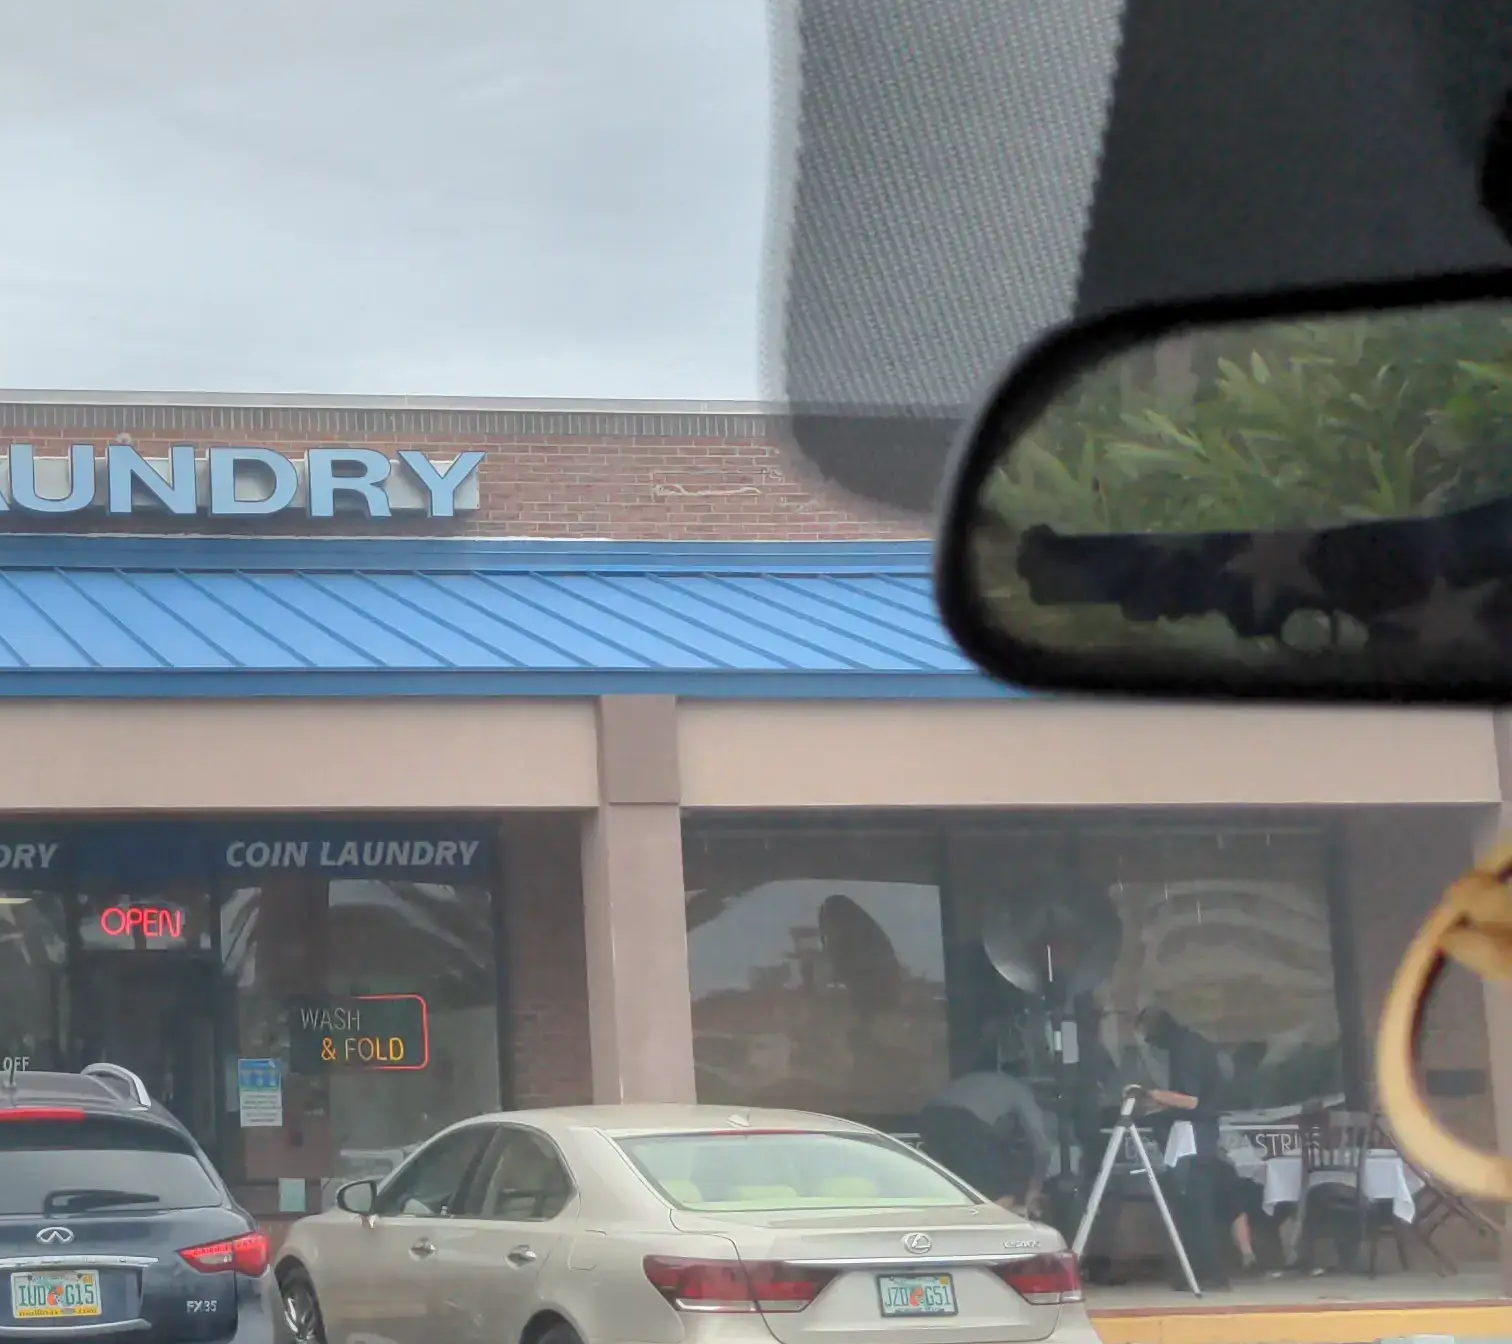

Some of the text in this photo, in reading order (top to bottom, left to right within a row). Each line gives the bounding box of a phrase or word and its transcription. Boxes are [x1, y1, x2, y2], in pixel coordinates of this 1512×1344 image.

[226, 840, 480, 867] COIN LAUNDRY
[101, 907, 181, 937] OPEN
[301, 1008, 360, 1031] WASH
[321, 1037, 405, 1061] & FOLD
[3, 1056, 30, 1073] OFF
[65, 1284, 94, 1305] G15
